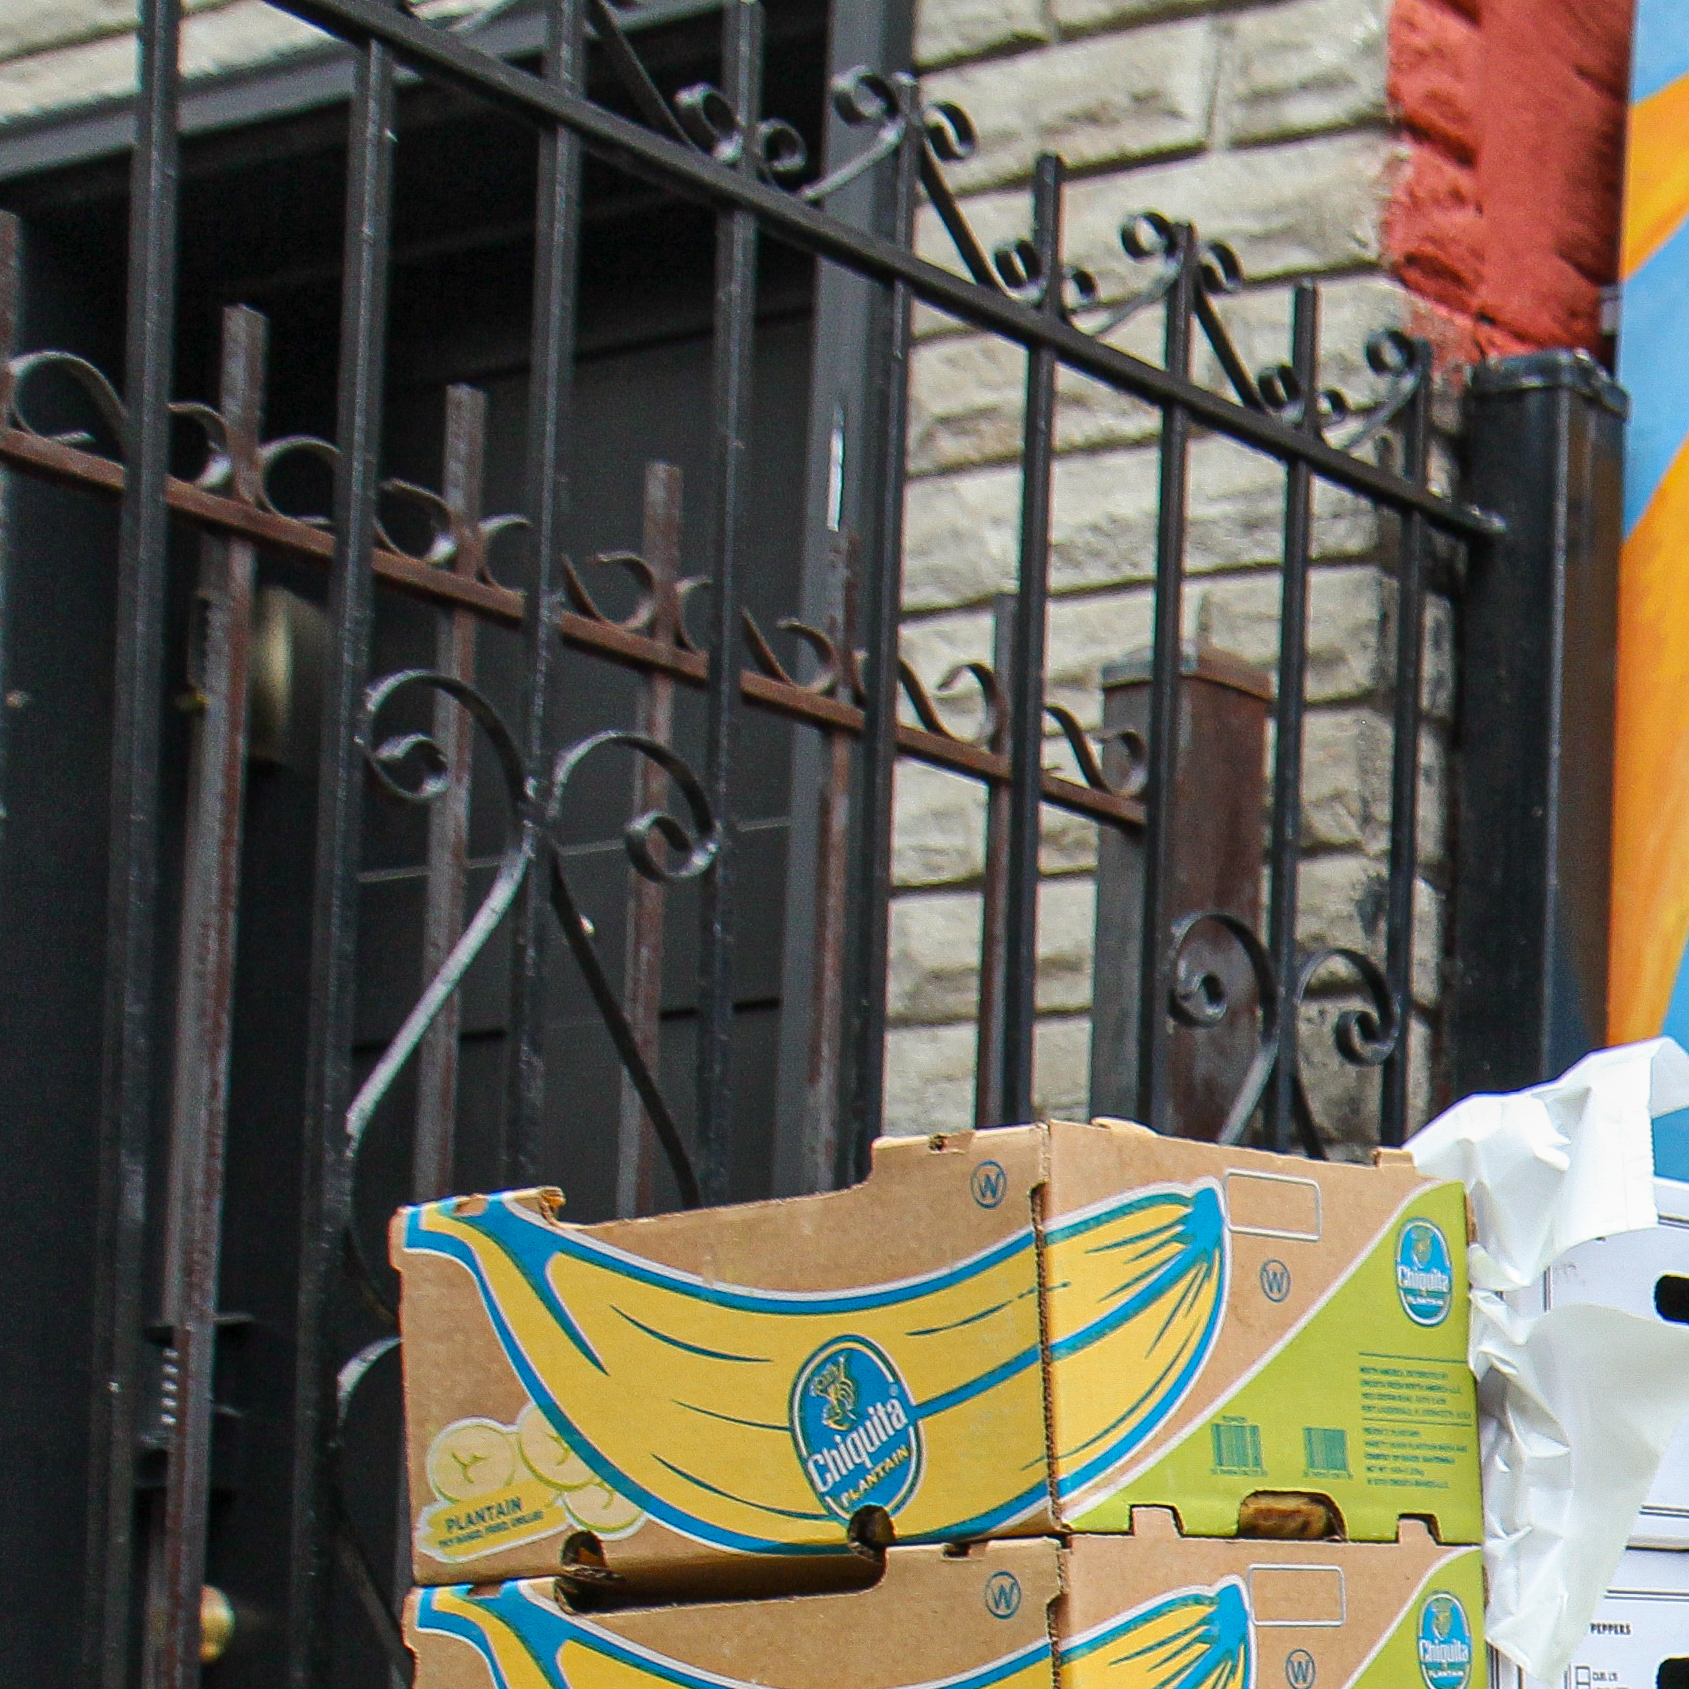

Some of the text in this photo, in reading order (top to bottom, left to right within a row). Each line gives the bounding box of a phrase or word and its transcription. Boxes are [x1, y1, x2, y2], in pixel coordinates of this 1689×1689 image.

[807, 1399, 908, 1493] Chiquita
[841, 1445, 910, 1507] PLANTAIN
[444, 1496, 522, 1533] PLANTAIN
[1590, 1623, 1631, 1635] PEPPERS
